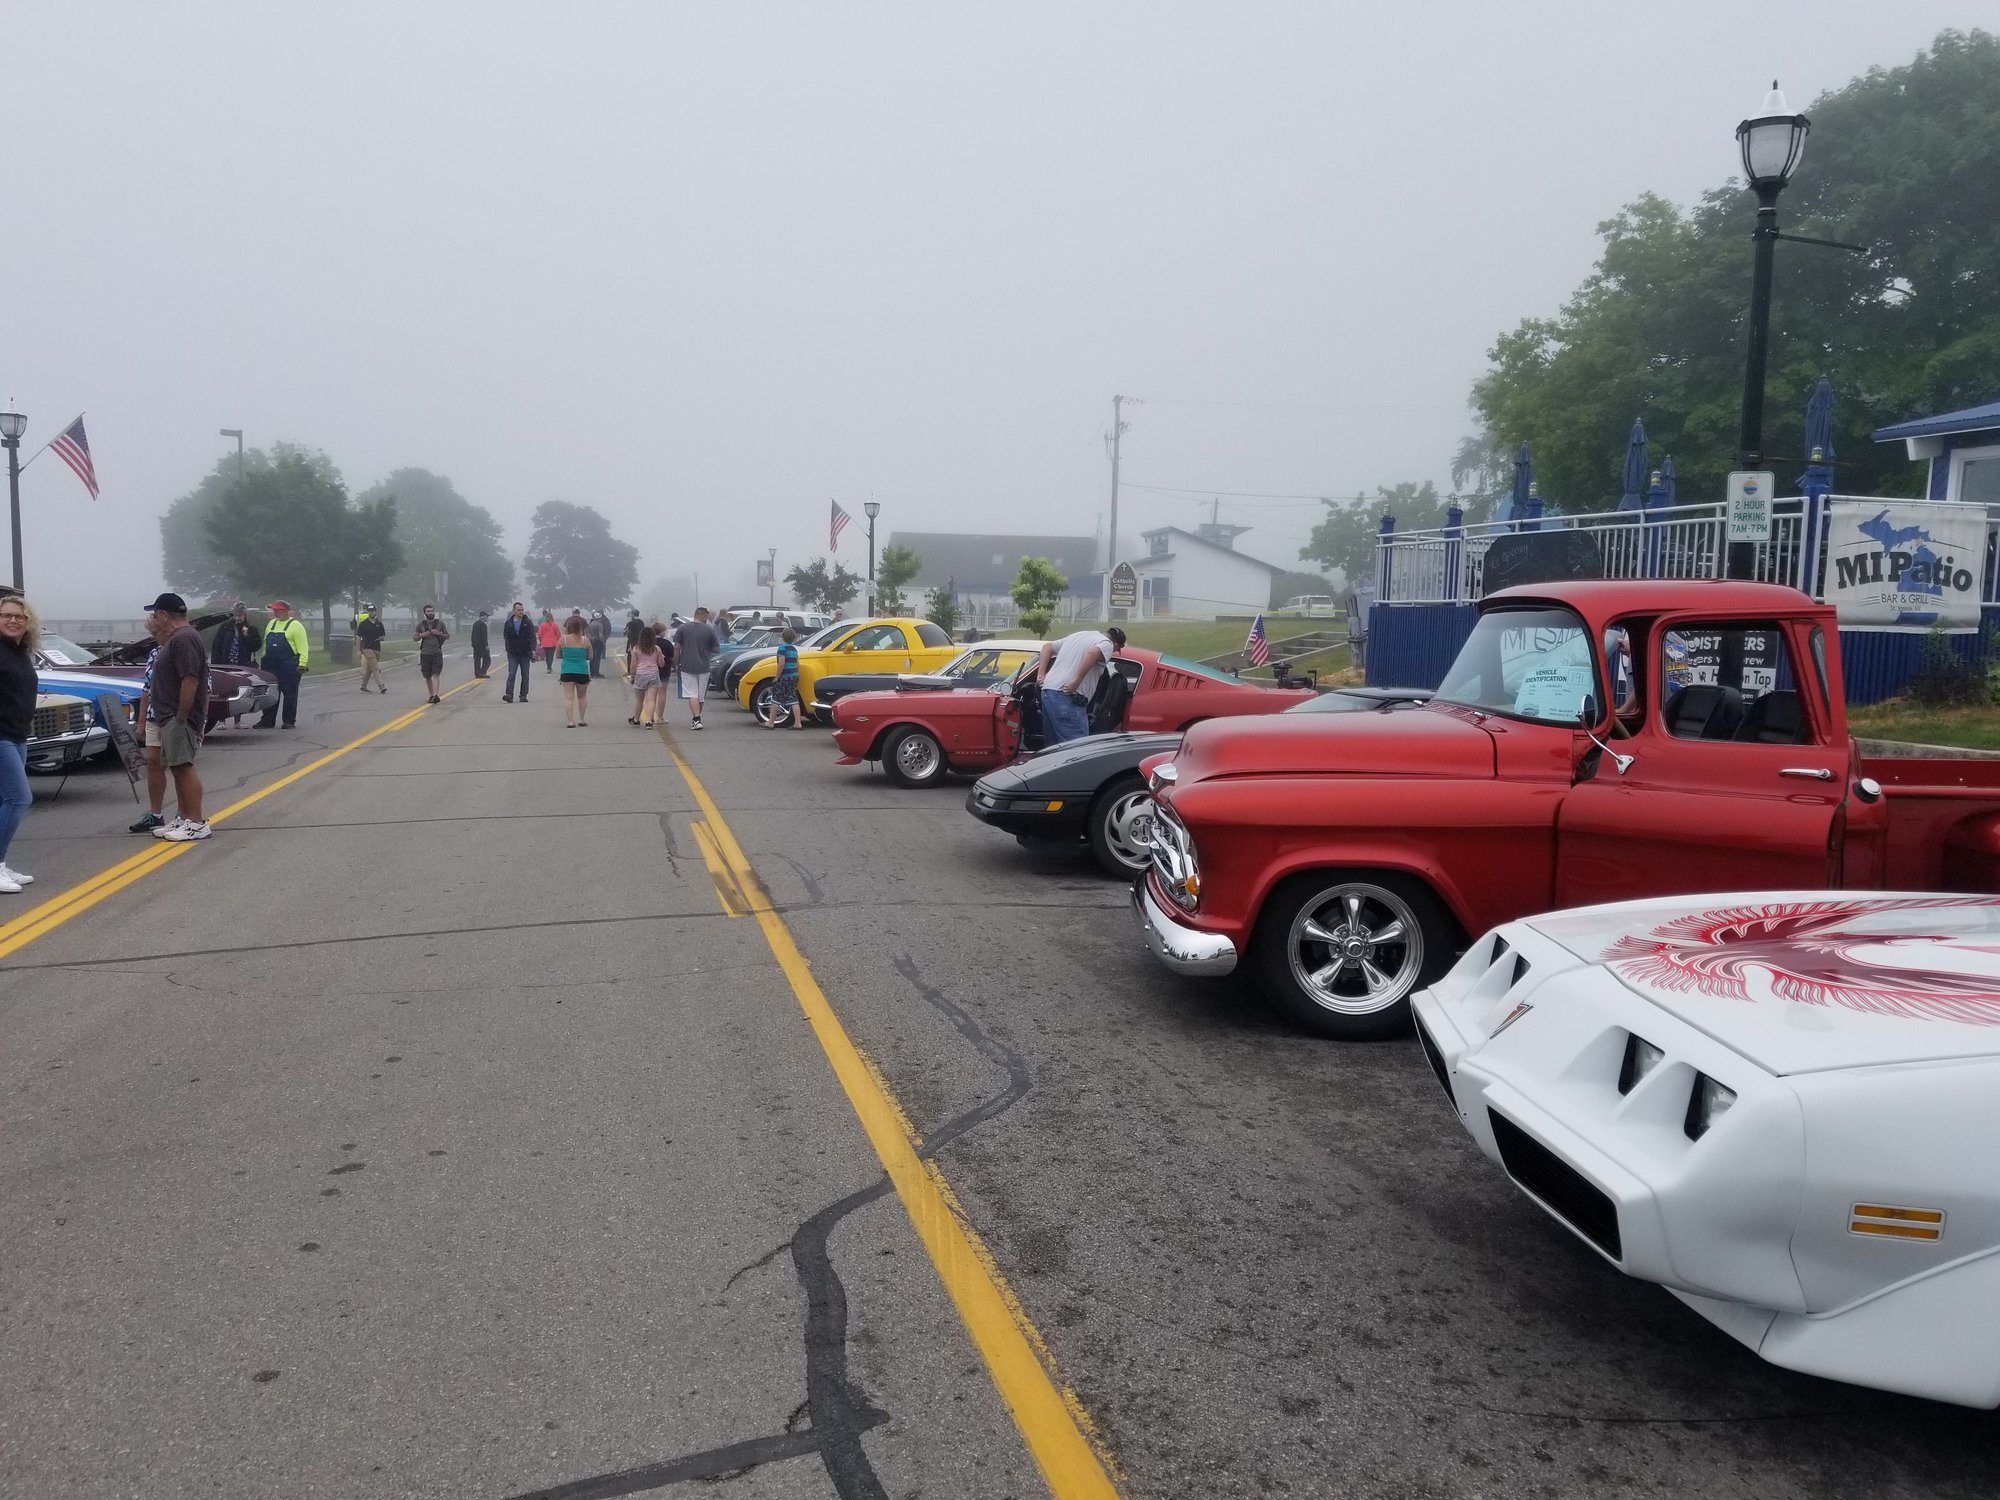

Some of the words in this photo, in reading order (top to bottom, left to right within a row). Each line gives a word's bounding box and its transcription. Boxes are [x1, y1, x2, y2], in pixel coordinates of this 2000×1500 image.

[1735, 501, 1740, 509] 2
[1744, 501, 1765, 509] HOUR
[1734, 512, 1766, 521] PARKING
[1731, 524, 1767, 533] 7AM-7PM
[1836, 552, 1883, 589] MI
[1888, 551, 1973, 592] Patio
[1881, 593, 1897, 603] BAR
[1900, 593, 1907, 603] &
[1908, 593, 1928, 604] GRILL
[1753, 670, 1771, 689] Tap
